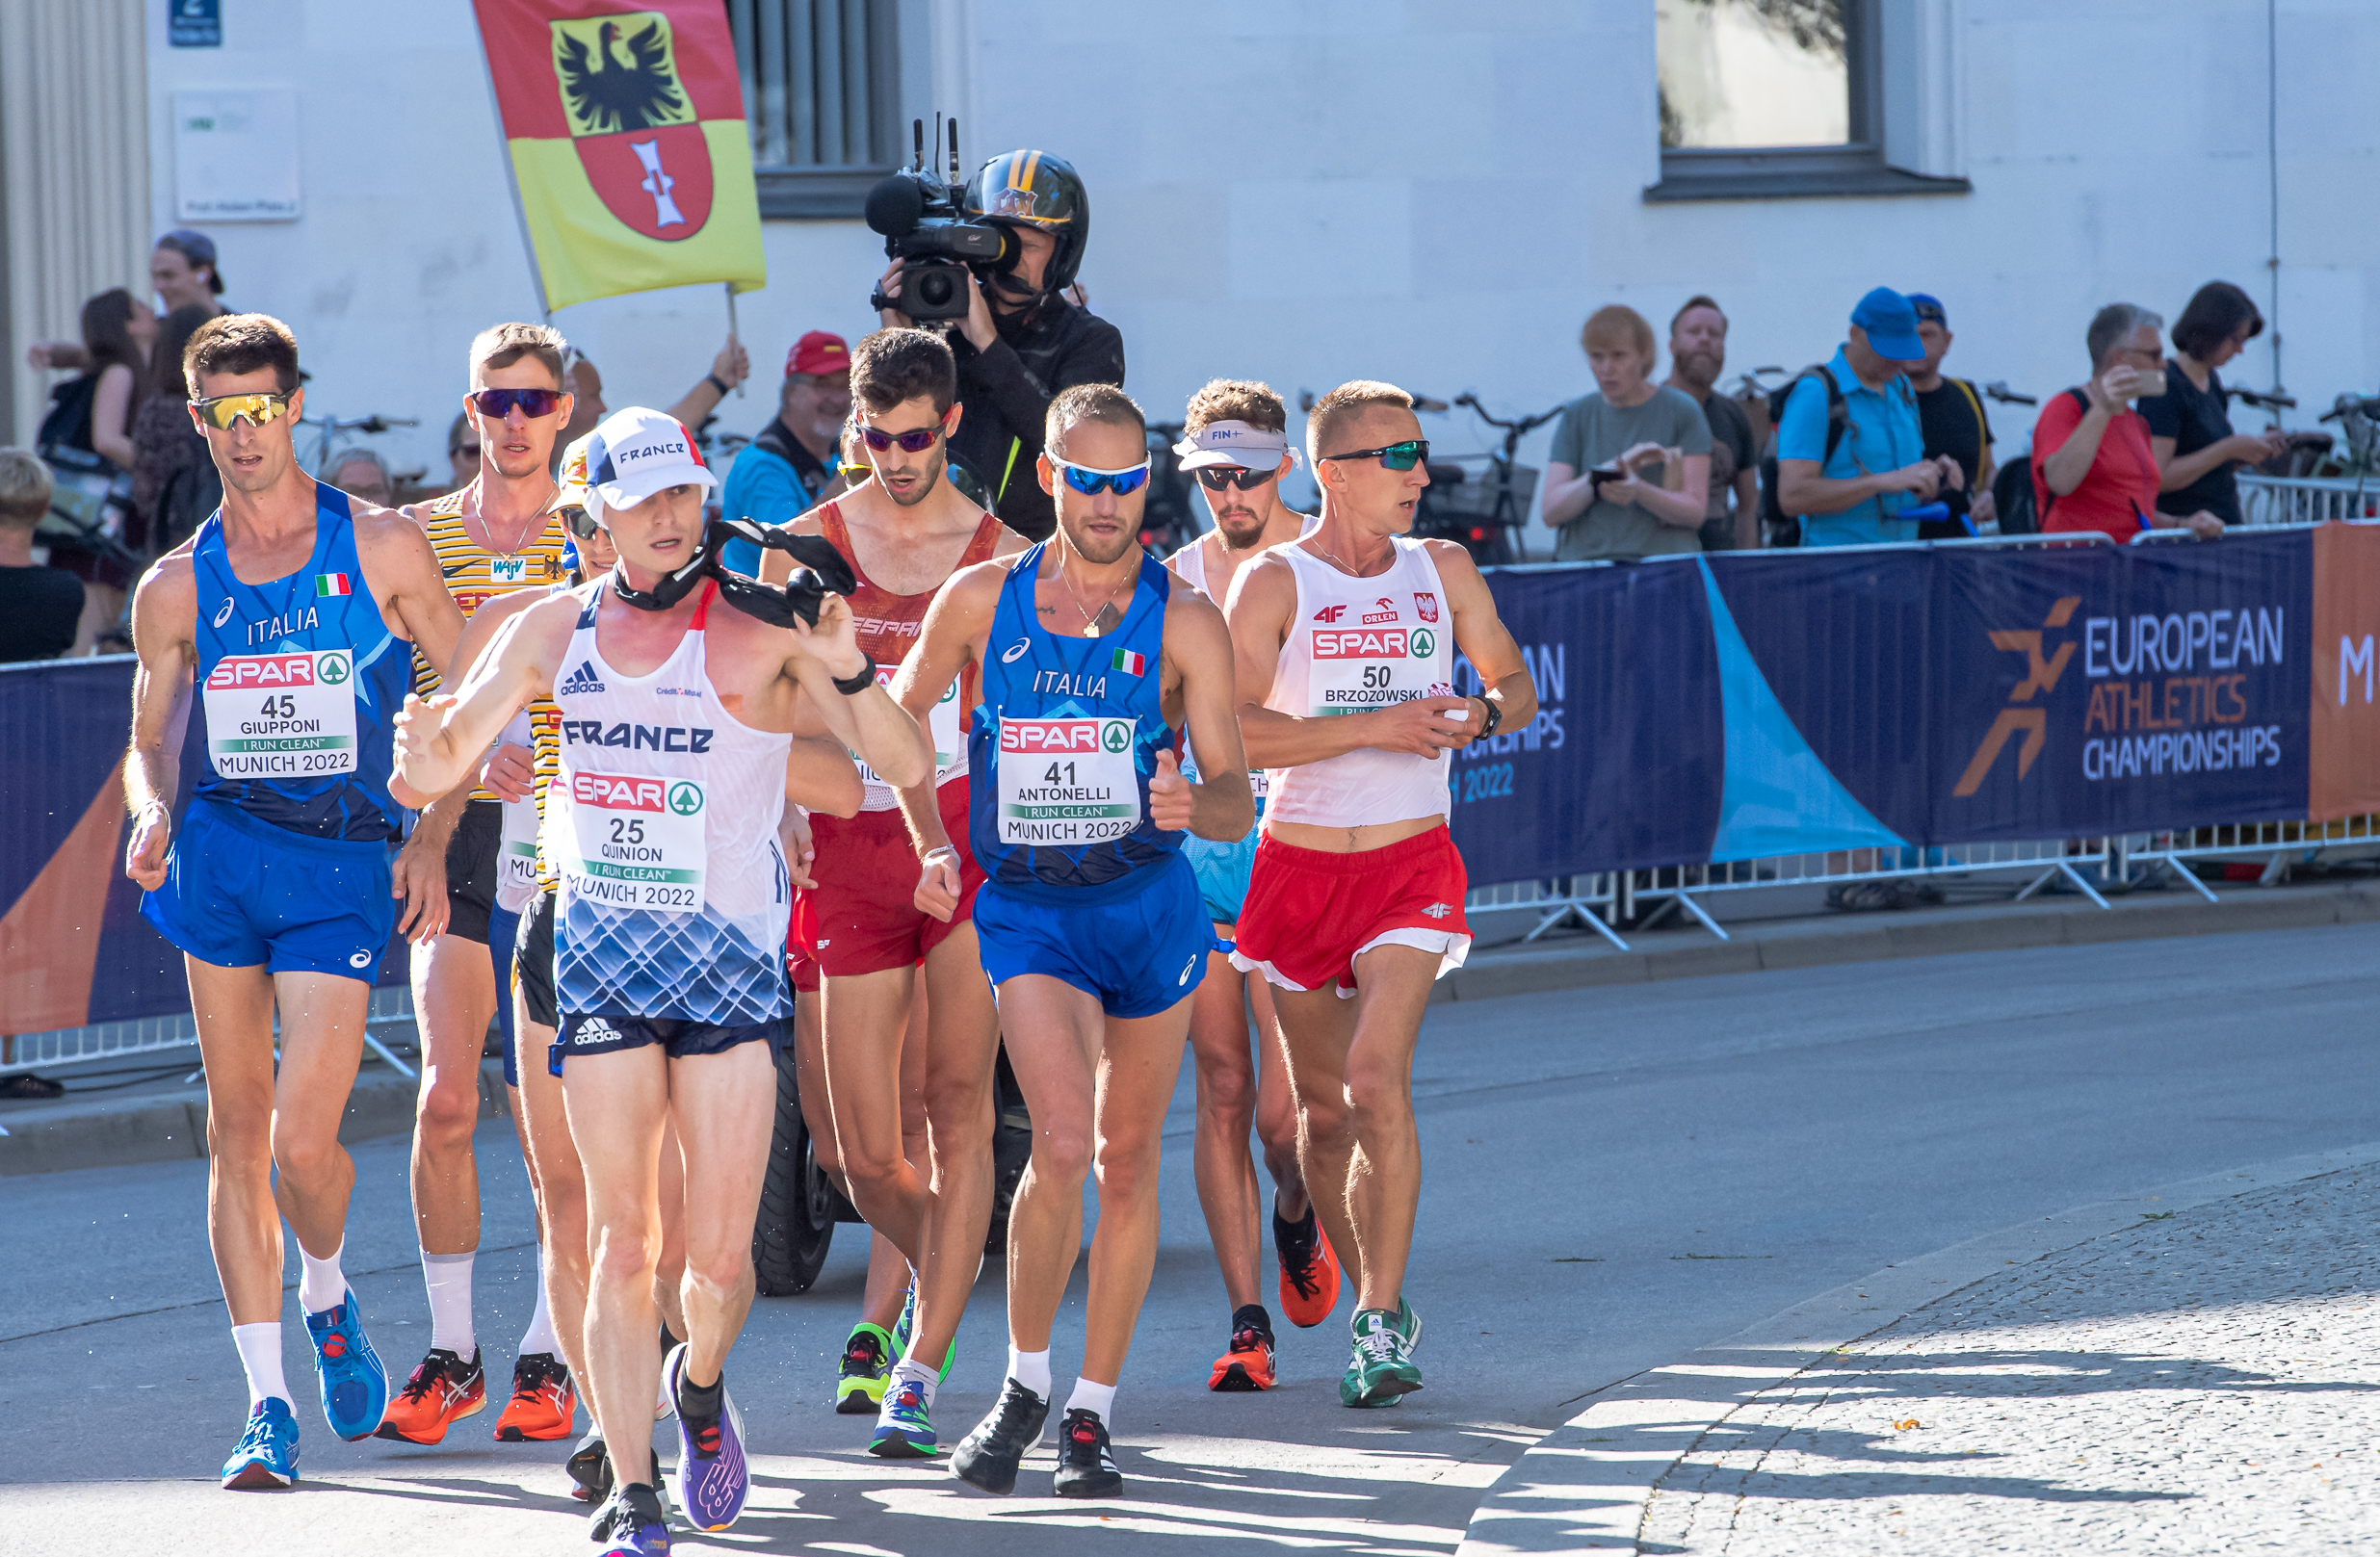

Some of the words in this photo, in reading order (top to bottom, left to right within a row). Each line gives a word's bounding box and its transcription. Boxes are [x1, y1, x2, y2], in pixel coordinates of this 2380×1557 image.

[1212, 429, 1231, 441] FIN
[619, 443, 685, 464] FRANCE
[1313, 605, 1347, 623] 4F
[1364, 612, 1397, 624] ORLEN
[247, 607, 319, 646] ITALIA
[1316, 632, 1405, 656] SPAR
[2083, 606, 2284, 678] EUROPEAN
[209, 661, 311, 687] SPAR
[1363, 666, 1392, 688] 50
[561, 682, 606, 696] adidas
[1033, 670, 1107, 700] ITALIA
[1325, 689, 1424, 703] BRZOZOWSKI
[2084, 674, 2247, 733] ATHLETICS
[260, 695, 296, 719] 45
[240, 719, 321, 735] GIUPPONI
[562, 721, 714, 754] FRANCE
[1000, 724, 1096, 749] SPAR
[244, 740, 248, 751] I
[250, 740, 276, 751] RUN
[2082, 725, 2281, 781] CHAMPIONSHIPS
[220, 757, 296, 774] MUNICH
[302, 753, 350, 771] 2022
[1044, 762, 1076, 786] 41
[574, 775, 665, 809] SPAR
[1464, 763, 1514, 803] 2022
[1018, 787, 1111, 801] ANTONELLI
[1025, 808, 1029, 817] I
[1031, 807, 1059, 818] RUN
[609, 818, 645, 845] 25
[1007, 821, 1078, 840] MUNICH
[1085, 819, 1133, 839] 2022
[601, 843, 663, 863] QUINION
[602, 865, 622, 877] RUN
[567, 874, 637, 903] MUNICH
[645, 886, 695, 906] 2022
[1421, 901, 1454, 920] 4F
[574, 1027, 623, 1046] adidas
